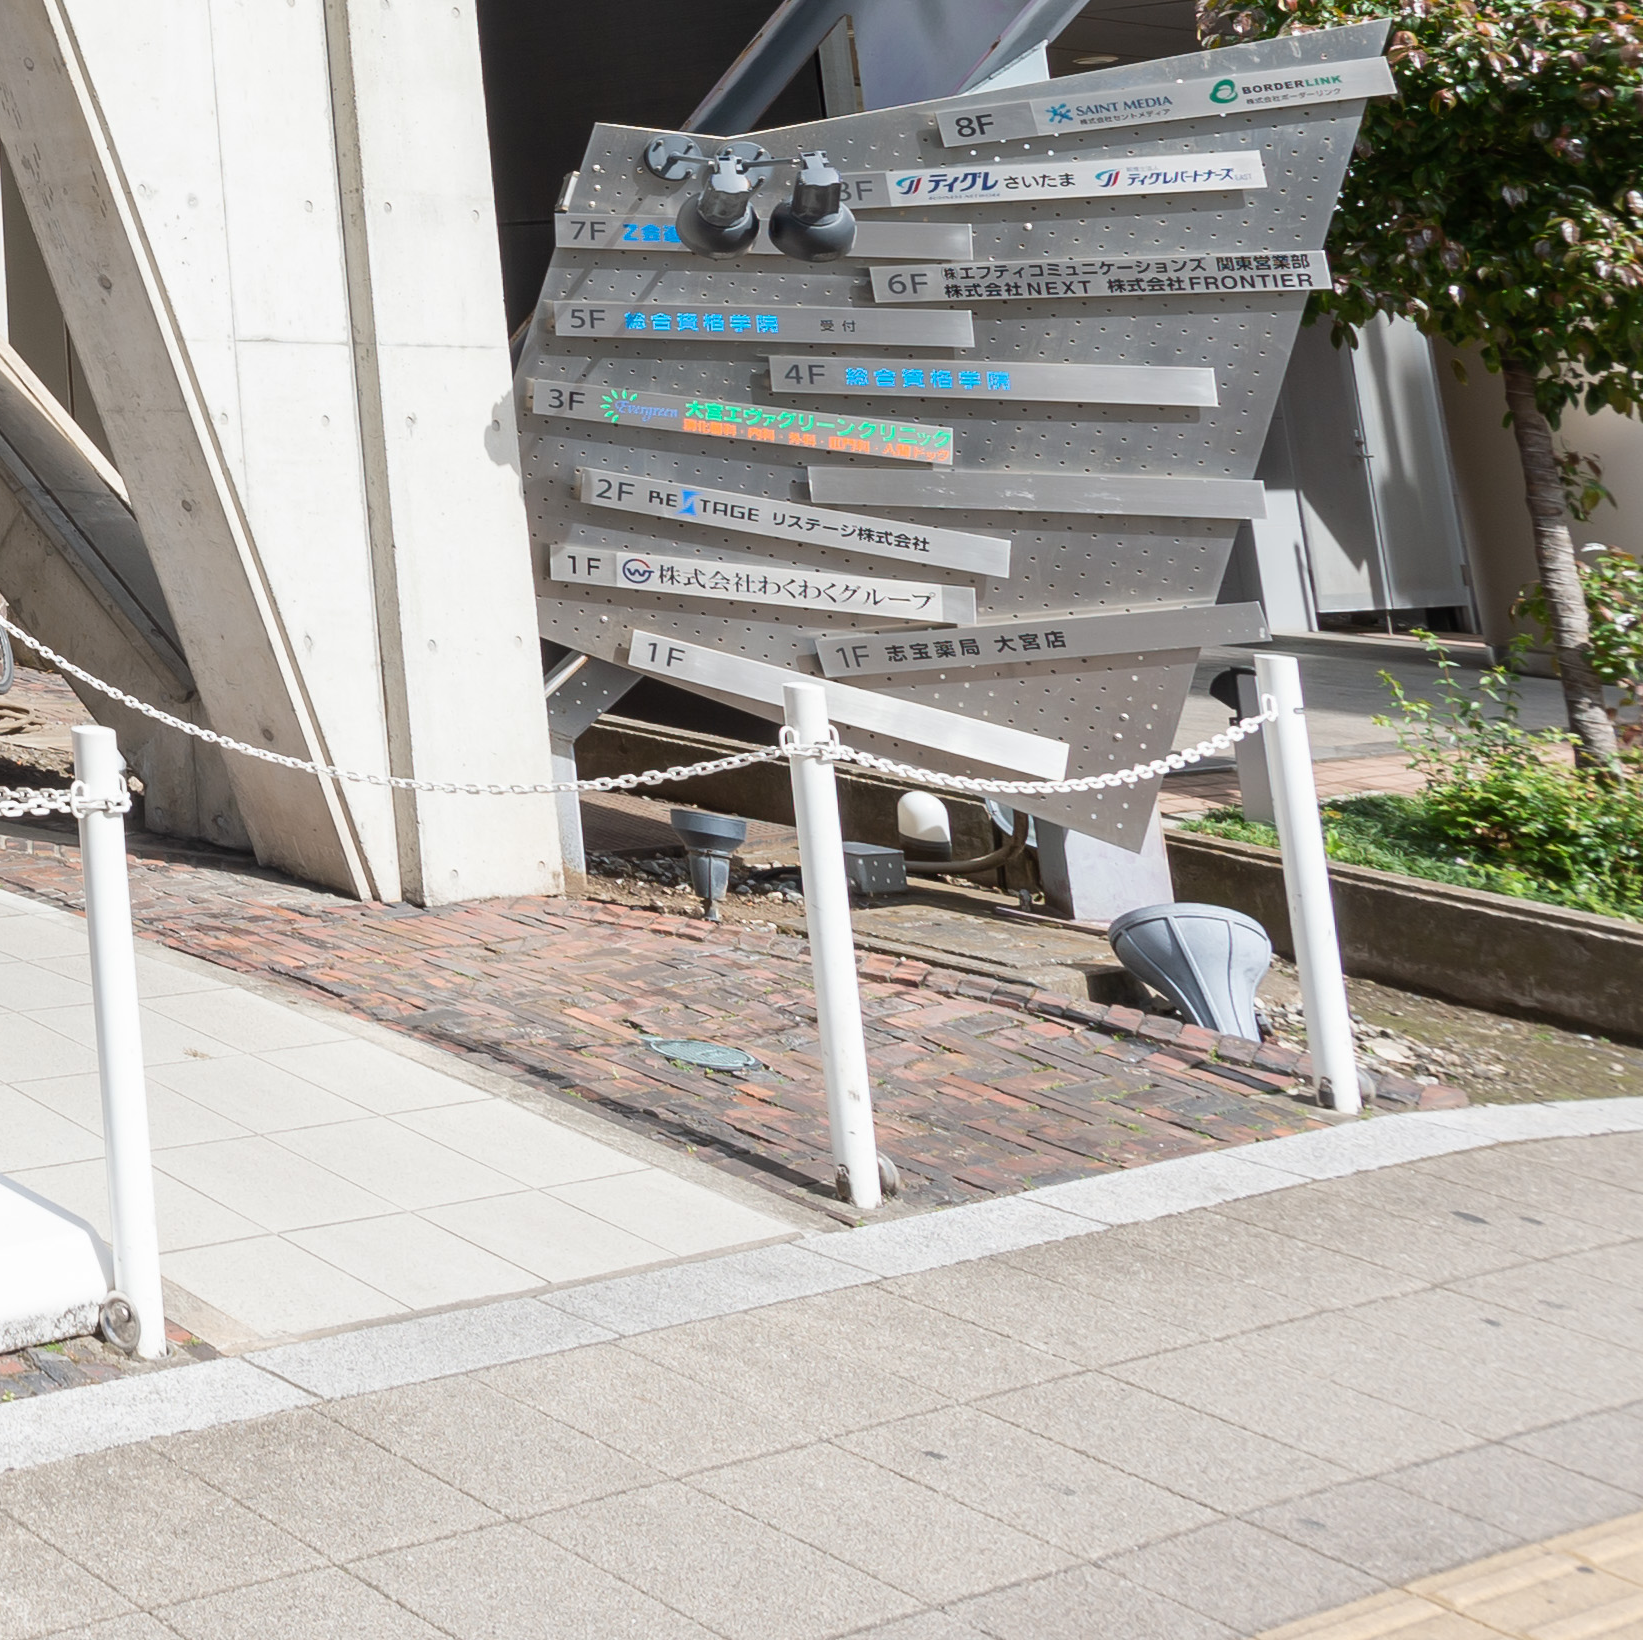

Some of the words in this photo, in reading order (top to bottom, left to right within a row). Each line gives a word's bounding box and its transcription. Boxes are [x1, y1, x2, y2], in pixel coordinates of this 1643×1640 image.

[1241, 75, 1344, 95] BORDERLINK
[1246, 87, 1342, 105] 株式会社ボーダーリンク
[1076, 101, 1120, 117] SAINT
[1121, 95, 1174, 112] MEDIA
[1079, 108, 1171, 126] 株式会社セントメディア
[955, 114, 995, 139] 8F
[927, 171, 999, 194] ティグレ
[1004, 173, 1076, 191] さいたま
[1127, 168, 1235, 187] ティグレパートナーズ
[570, 221, 606, 240] 7F
[1216, 254, 1311, 272] 関東営業部
[886, 273, 929, 295] 6F
[944, 279, 1092, 299] 株式会社NEXT
[1107, 272, 1314, 294] 株式会社FRONTIER
[570, 309, 606, 329] 5F
[624, 311, 780, 334] 総合資格学院
[819, 318, 856, 333] 受付
[784, 364, 826, 385] 4F
[845, 366, 1011, 391] 総合資格学院
[547, 388, 586, 411] 3F
[615, 397, 678, 421] Evergreen
[684, 399, 952, 448] 大宮エヴァグリーンクリニック
[595, 477, 636, 502] 2F
[773, 510, 930, 553] リステージ株式会社
[567, 553, 601, 577] 1F
[659, 563, 936, 611] 株式会社わくわくグループ
[646, 641, 686, 668] 1F
[834, 644, 870, 669] 1F
[884, 637, 980, 662] 志宝薬局
[994, 630, 1067, 654] 大宮店
